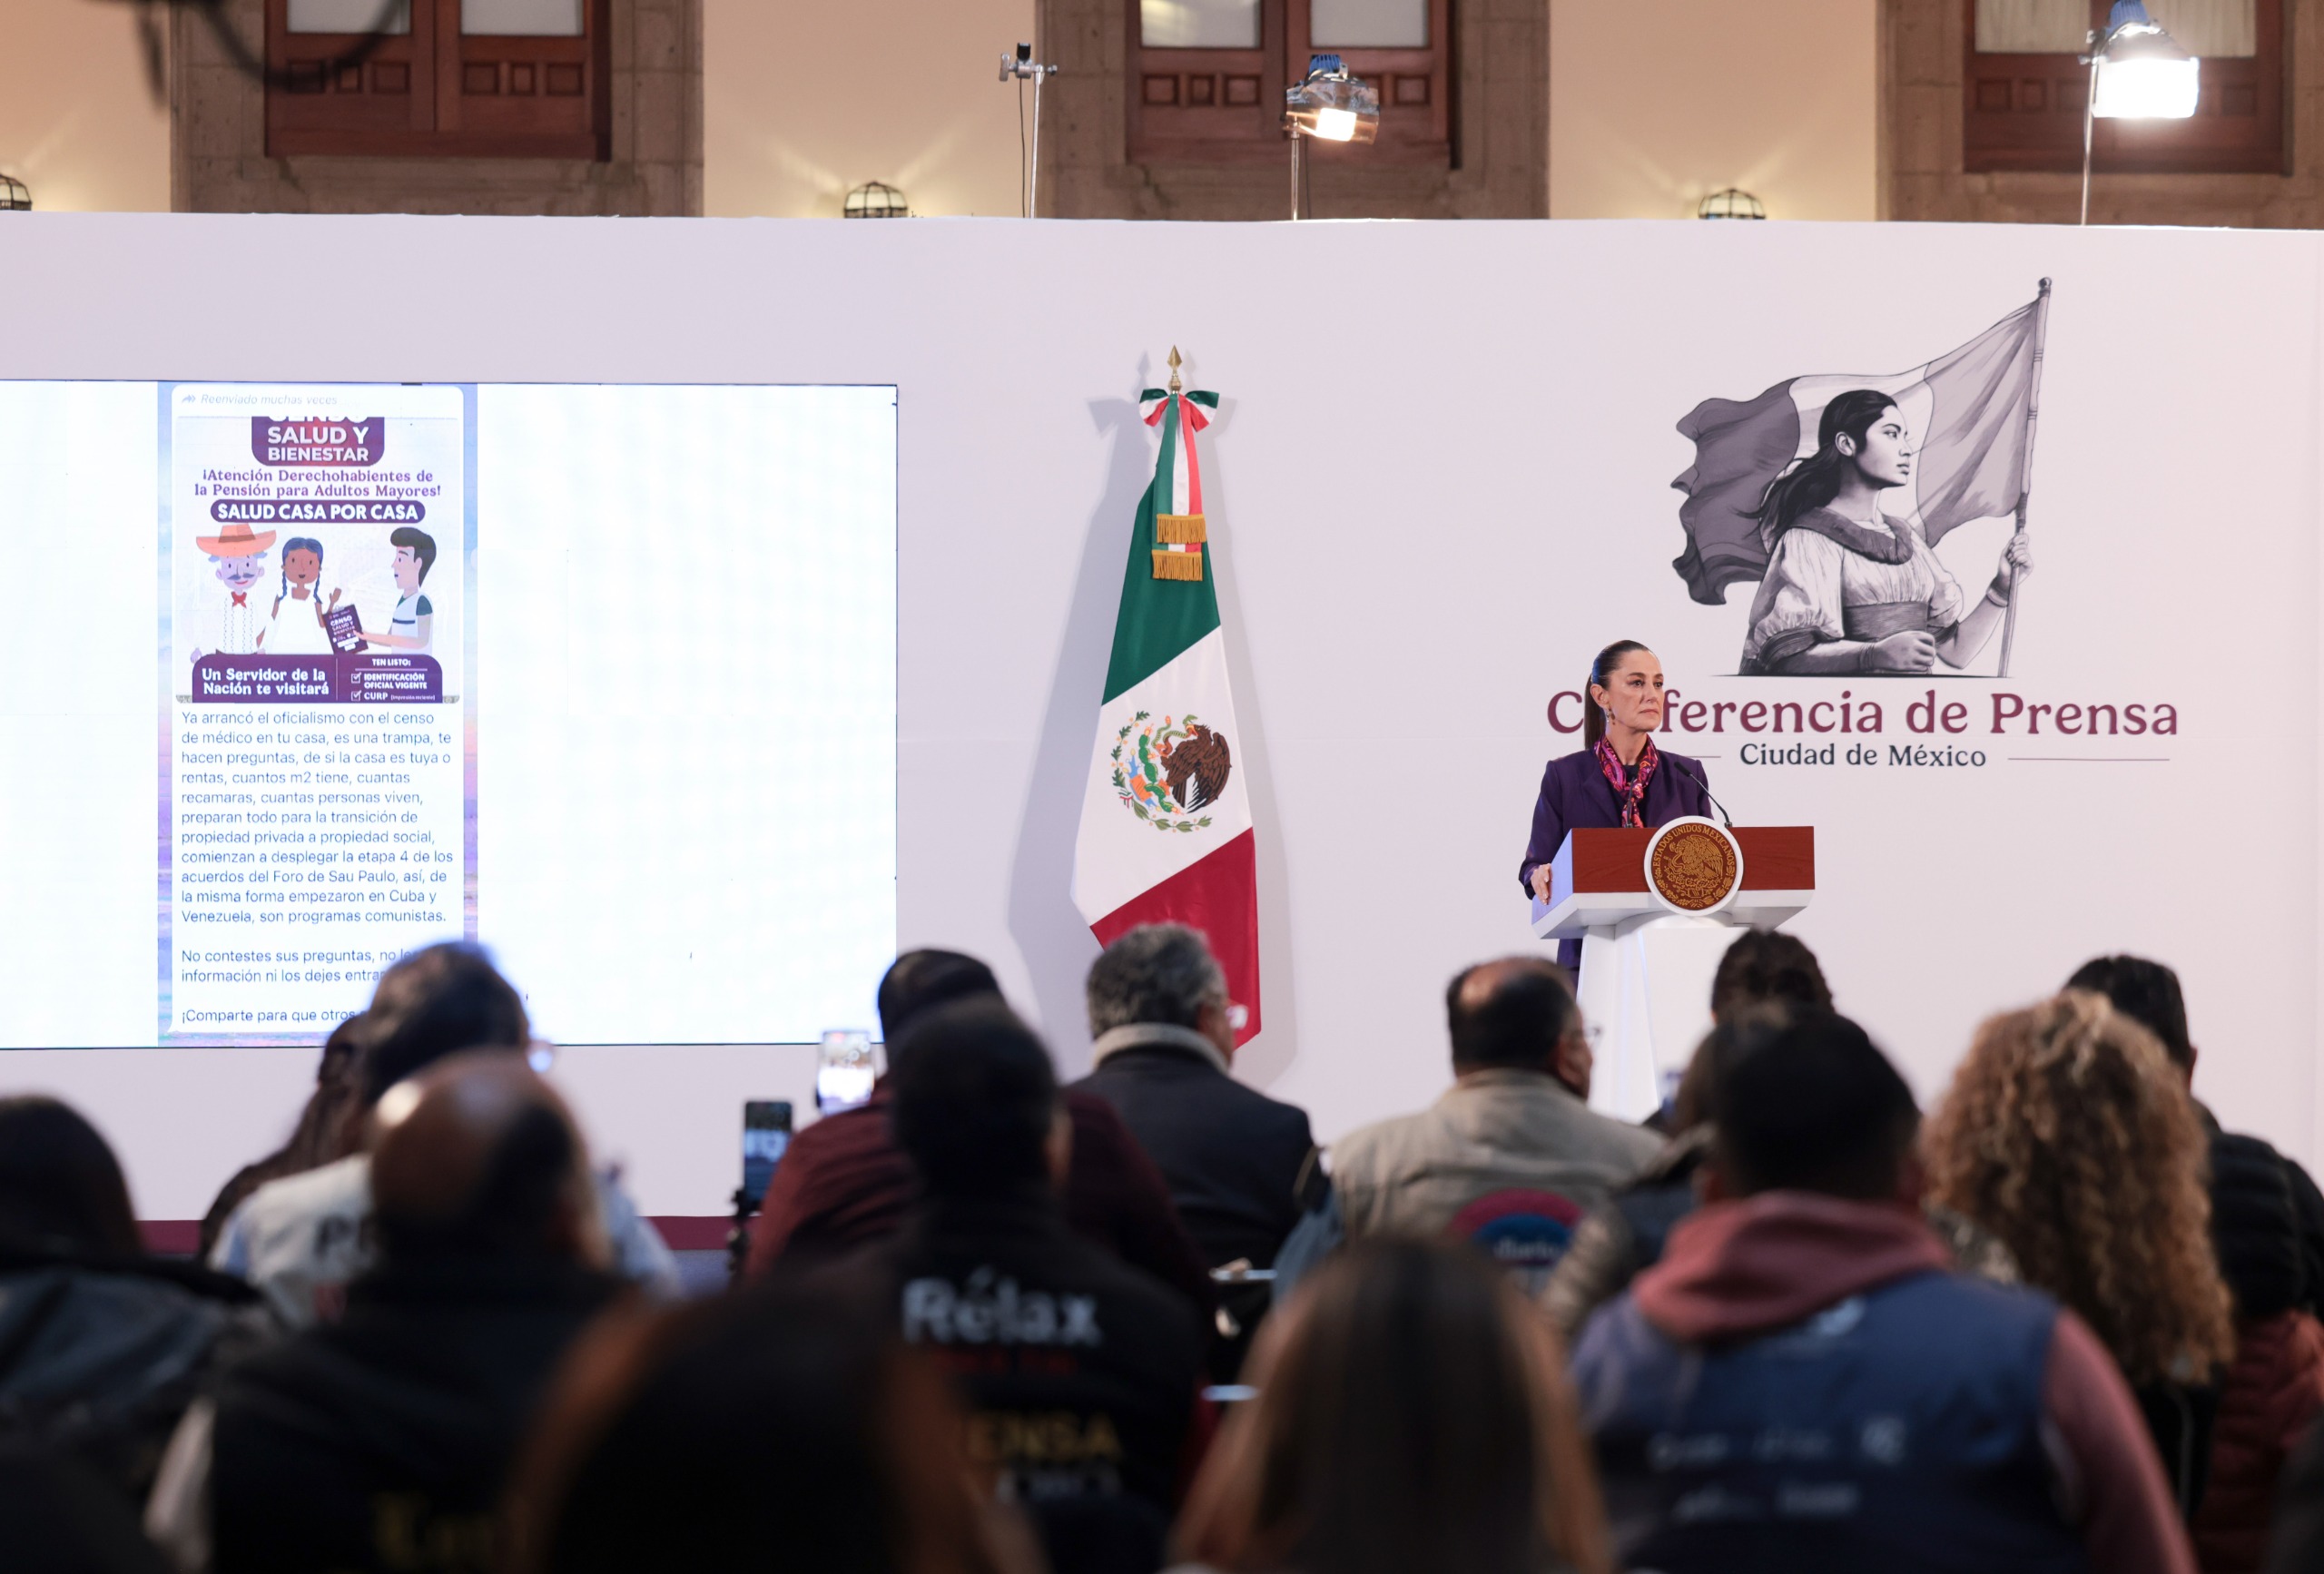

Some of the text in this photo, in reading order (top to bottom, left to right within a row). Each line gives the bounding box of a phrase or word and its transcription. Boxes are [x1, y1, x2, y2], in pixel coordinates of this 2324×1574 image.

[202, 394, 258, 405] Reenviado
[261, 395, 301, 404] muchas
[268, 427, 369, 444] SALUD Y
[269, 448, 369, 461] BIENESTAR
[203, 468, 432, 482] ¡Atención Derechohabientes de
[195, 483, 440, 499] la Pensión para Adultos Mayores!
[218, 503, 419, 520] SALUD CASA POR CASA
[202, 668, 327, 681] Un Servidor de la
[364, 673, 425, 681] IDENTIFICACIÓN
[204, 681, 329, 694] Nación te visitará
[364, 692, 388, 700] CURP
[182, 712, 434, 723] Ya arrancó el oficialismo con el censo
[1547, 689, 2177, 735] Cferencia de Prensa
[182, 731, 451, 746] de médico en tu casa, es una trampa, te
[182, 752, 450, 766] hacen preguntas, de si la casa es tuya o
[1740, 743, 1985, 766] Ciudad de México
[182, 772, 409, 785] rentas, cuantos m2 tiene, cuantas
[182, 791, 422, 805] recamaras, cuantas personas viven,
[182, 811, 418, 825] preparan todo para la transición de
[182, 831, 434, 845] propiedad privada a propiedad social,
[1653, 824, 1735, 868] ESTADOS UNIDOS MEXICANOS
[182, 851, 453, 865] comienzan a desplegar la etapa 4 de los
[182, 870, 447, 883] acuerdos del Foro de Sau Paulo, así, de
[182, 890, 436, 904] la misma forma empezaron en Cuba y
[182, 910, 446, 924] Venezuela, son programas comunistas.
[182, 950, 200, 962] No
[205, 951, 271, 962] contestes
[276, 952, 299, 961] sus
[303, 950, 374, 964] preguntas,
[380, 952, 397, 960] no
[182, 969, 261, 982] información
[266, 969, 276, 982] ni
[281, 969, 300, 981] los
[305, 969, 340, 983] dejes
[182, 1009, 252, 1023] ¡Comparte
[258, 1012, 287, 1023] para
[292, 1012, 317, 1022] que
[321, 1010, 355, 1020] otros
[903, 1264, 1101, 1348] Rélax
